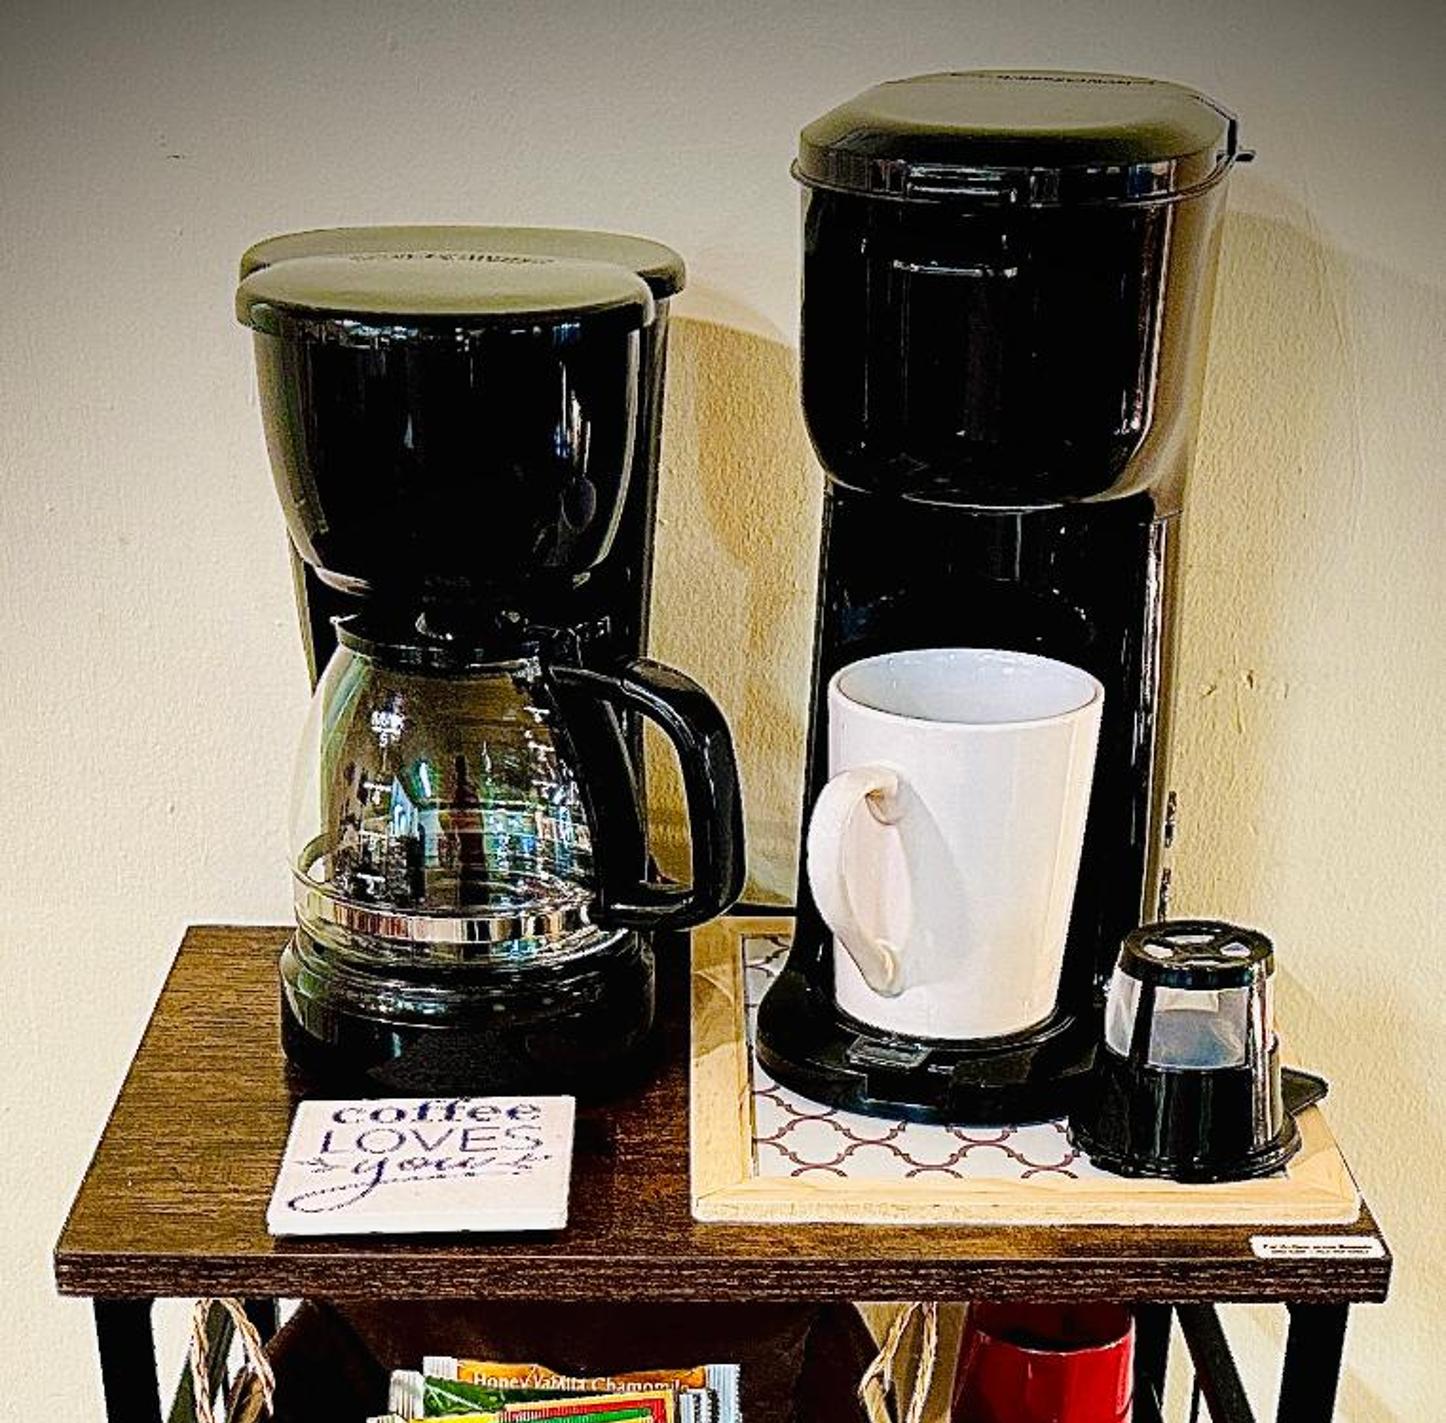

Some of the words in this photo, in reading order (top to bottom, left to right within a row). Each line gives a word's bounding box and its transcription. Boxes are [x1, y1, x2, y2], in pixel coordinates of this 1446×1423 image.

[331, 1096, 543, 1125] coffee
[319, 1126, 545, 1156] LOVES
[287, 1155, 500, 1213] you
[472, 1371, 529, 1390] Honey
